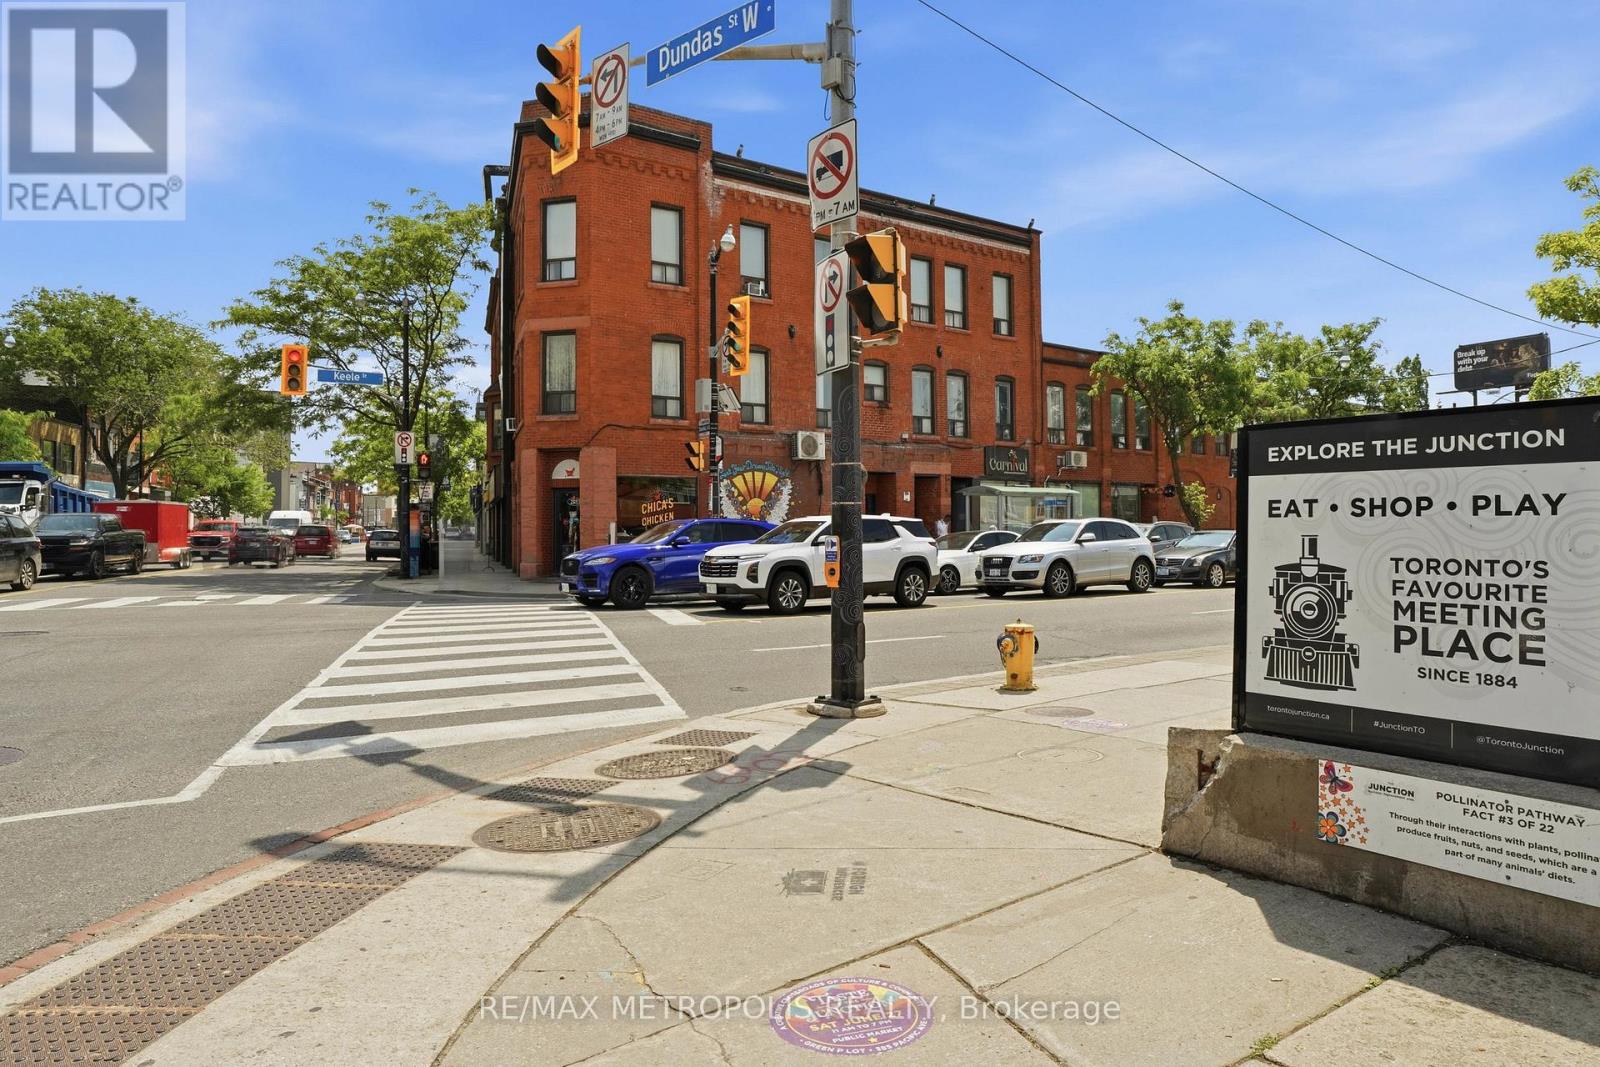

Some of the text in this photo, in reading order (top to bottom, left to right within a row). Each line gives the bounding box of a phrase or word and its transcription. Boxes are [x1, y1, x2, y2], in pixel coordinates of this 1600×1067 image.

[659, 2, 759, 72] Dundas St W
[1457, 349, 1485, 358] Break up
[1473, 356, 1488, 365] your
[334, 371, 360, 381] Keele
[1268, 428, 1565, 462] EXPLORE THE JUNCTION
[642, 498, 674, 514] CHICA'S
[1268, 493, 1567, 518] EAT SHOP PLAY
[642, 512, 674, 526] CHICKEN
[1390, 557, 1549, 579] TORONTO'S
[1392, 580, 1548, 604] FAVOURITE
[1393, 600, 1546, 631] MEETING
[1393, 624, 1546, 667] PLACE
[1417, 666, 1519, 689] SINCE 1884
[1374, 720, 1426, 734] #JunctionTO
[1476, 736, 1565, 756] @TorontoJunction
[1368, 782, 1414, 798] JUNCTION
[1436, 791, 1514, 814] POLLINATOR
[1518, 807, 1586, 828] PATHWAY
[1462, 808, 1555, 834] FACT #3 OF 22
[1390, 812, 1600, 863] Through their interactions with plants, pollina
[1396, 826, 1597, 876] produce fruits, nuts, and seeds, which are a
[1444, 848, 1463, 858] part
[1477, 856, 1503, 868] many
[1506, 862, 1545, 876] animals'
[1547, 871, 1576, 884] diets.
[810, 1020, 837, 1032] SAT
[832, 1026, 903, 1044] PUBLIC MARKET
